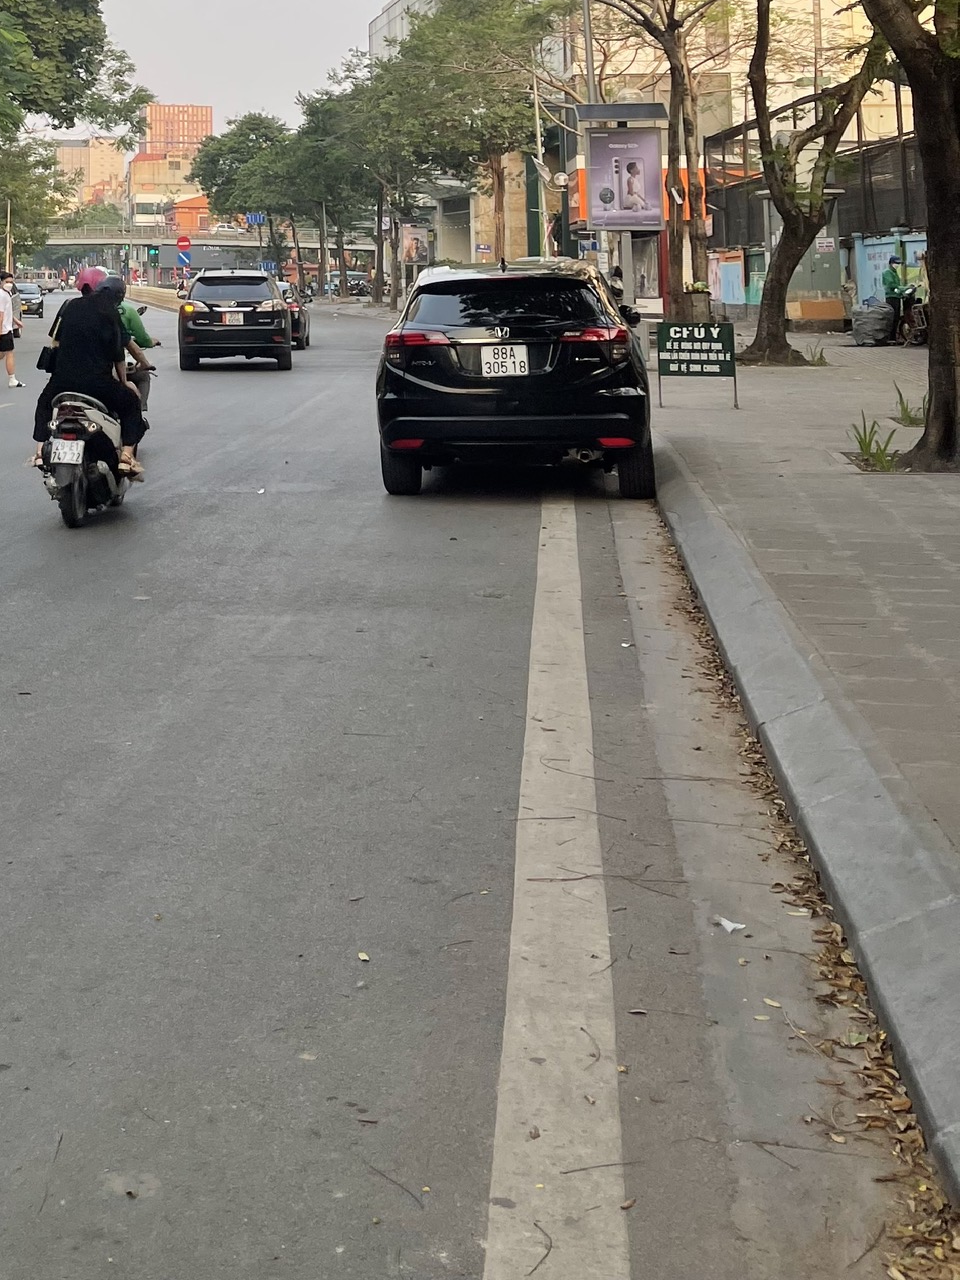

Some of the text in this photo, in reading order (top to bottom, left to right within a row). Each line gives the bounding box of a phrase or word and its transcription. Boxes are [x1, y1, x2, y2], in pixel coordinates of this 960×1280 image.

[709, 323, 721, 339] Ý
[492, 346, 516, 360] 88A
[484, 360, 527, 375] 305.18
